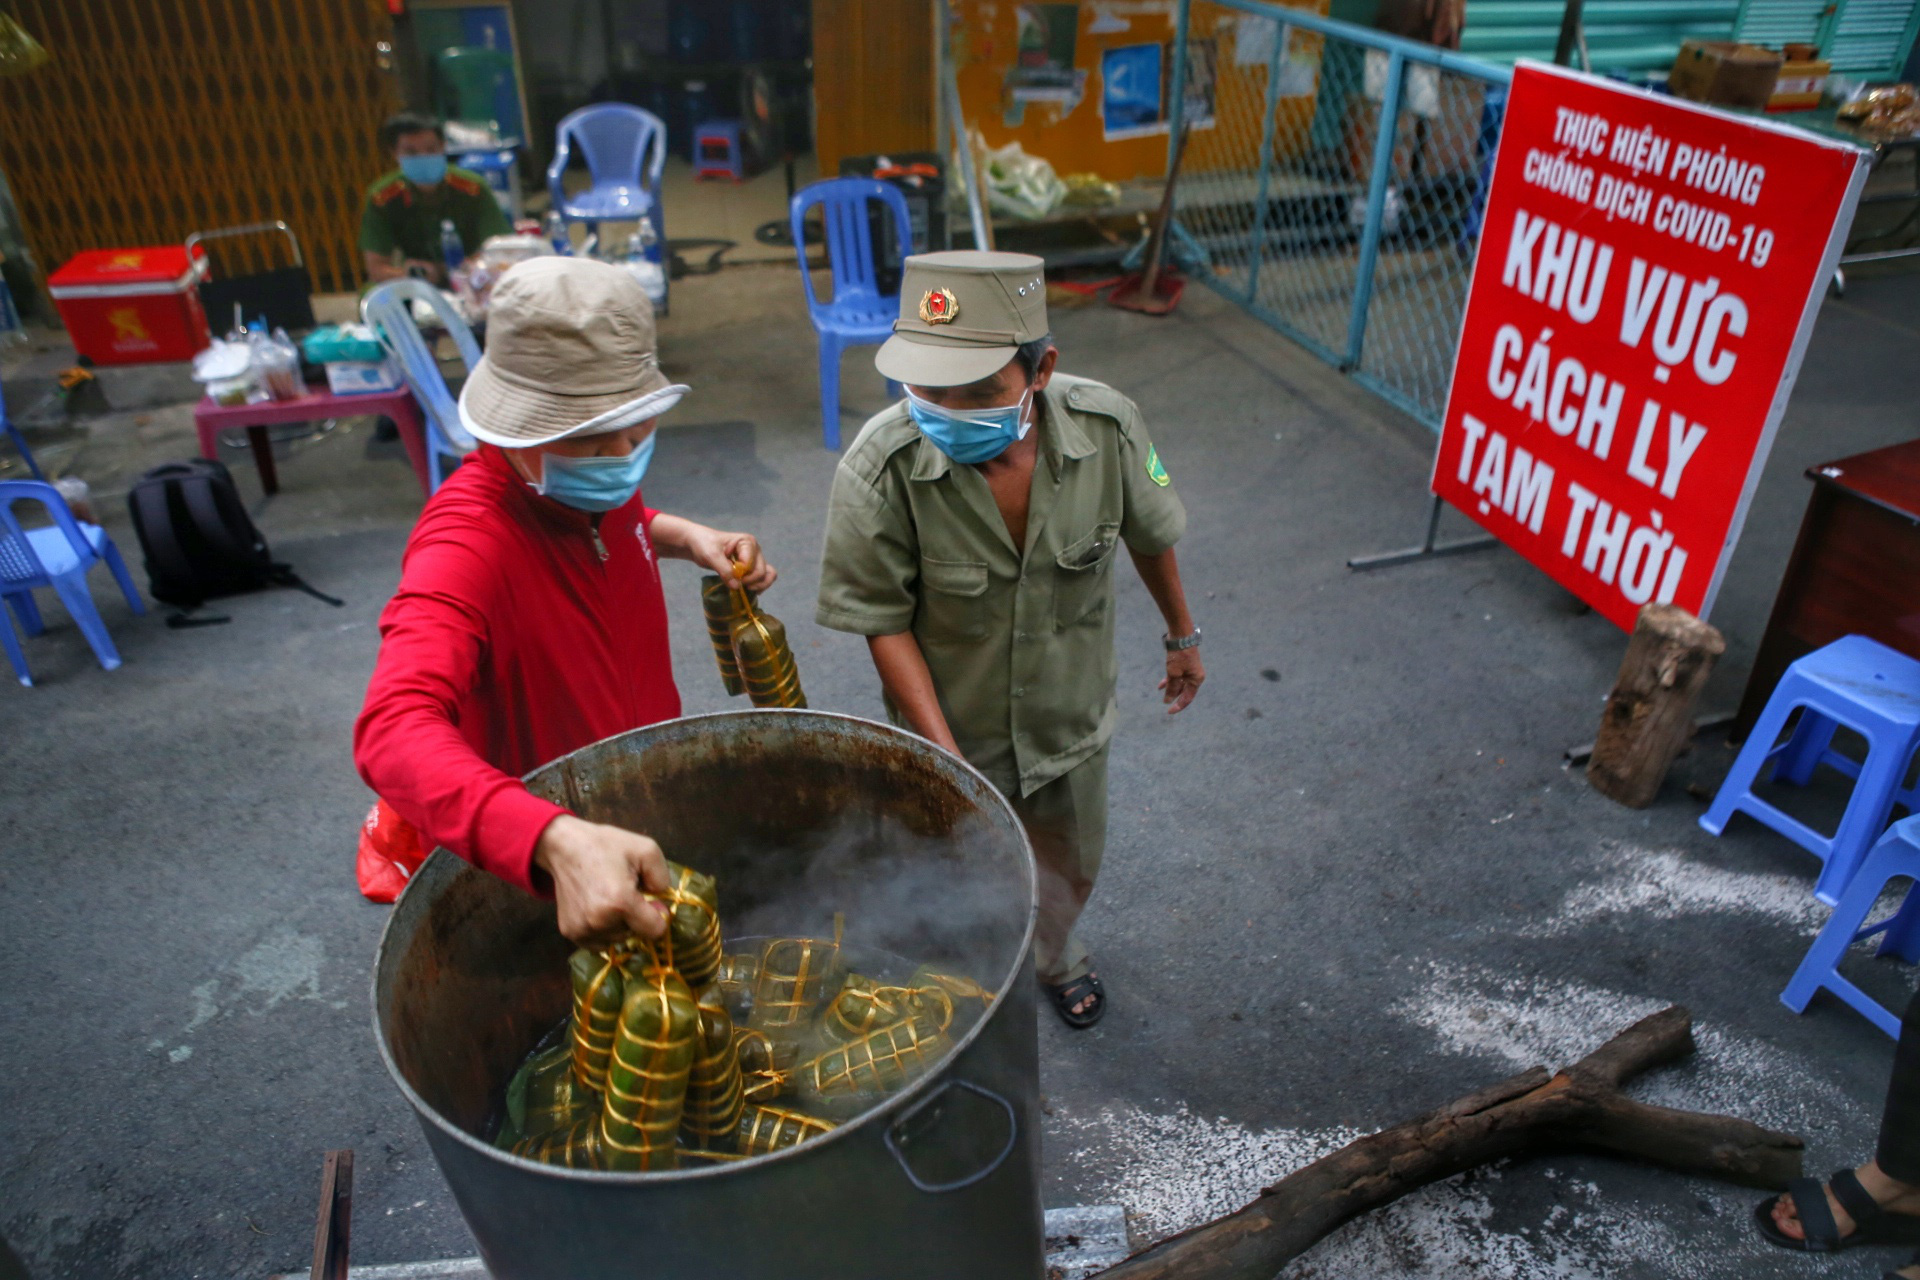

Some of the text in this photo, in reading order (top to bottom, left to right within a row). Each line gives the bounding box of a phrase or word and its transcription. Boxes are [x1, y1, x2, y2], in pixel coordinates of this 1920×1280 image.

[1523, 147, 1775, 268] CHỐNG DỊCH COVID-19
[1553, 105, 1609, 159] THỰC
[1609, 124, 1670, 178] HIỆN
[1502, 210, 1748, 385] KHU VỰC
[1487, 324, 1707, 500] CÁCH LY
[1457, 413, 1689, 605] TẠM THỜI
